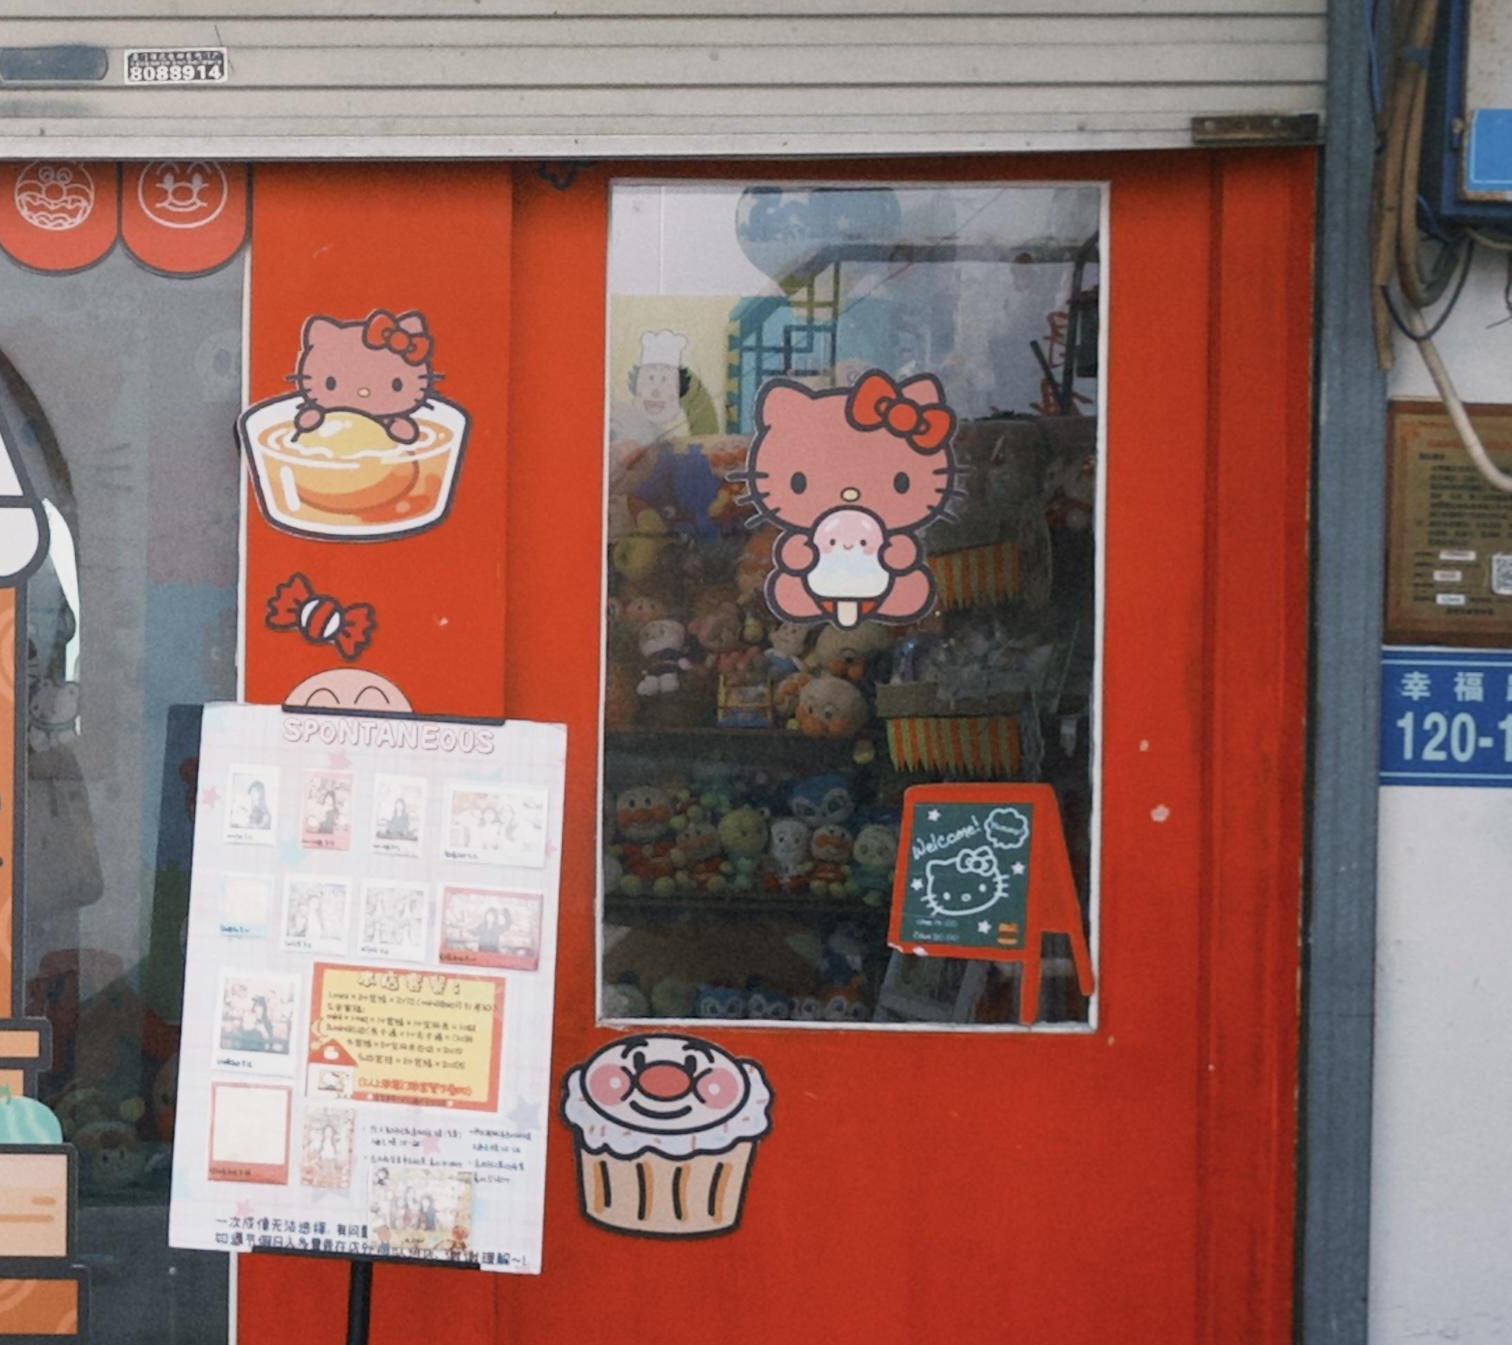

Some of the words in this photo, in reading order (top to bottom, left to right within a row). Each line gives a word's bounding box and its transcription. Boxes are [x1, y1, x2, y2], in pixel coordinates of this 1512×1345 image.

[129, 64, 222, 82] 8088914
[1401, 670, 1512, 702] 幸福
[282, 717, 496, 755] SPONTANEOUS
[912, 815, 982, 860] Welcome!
